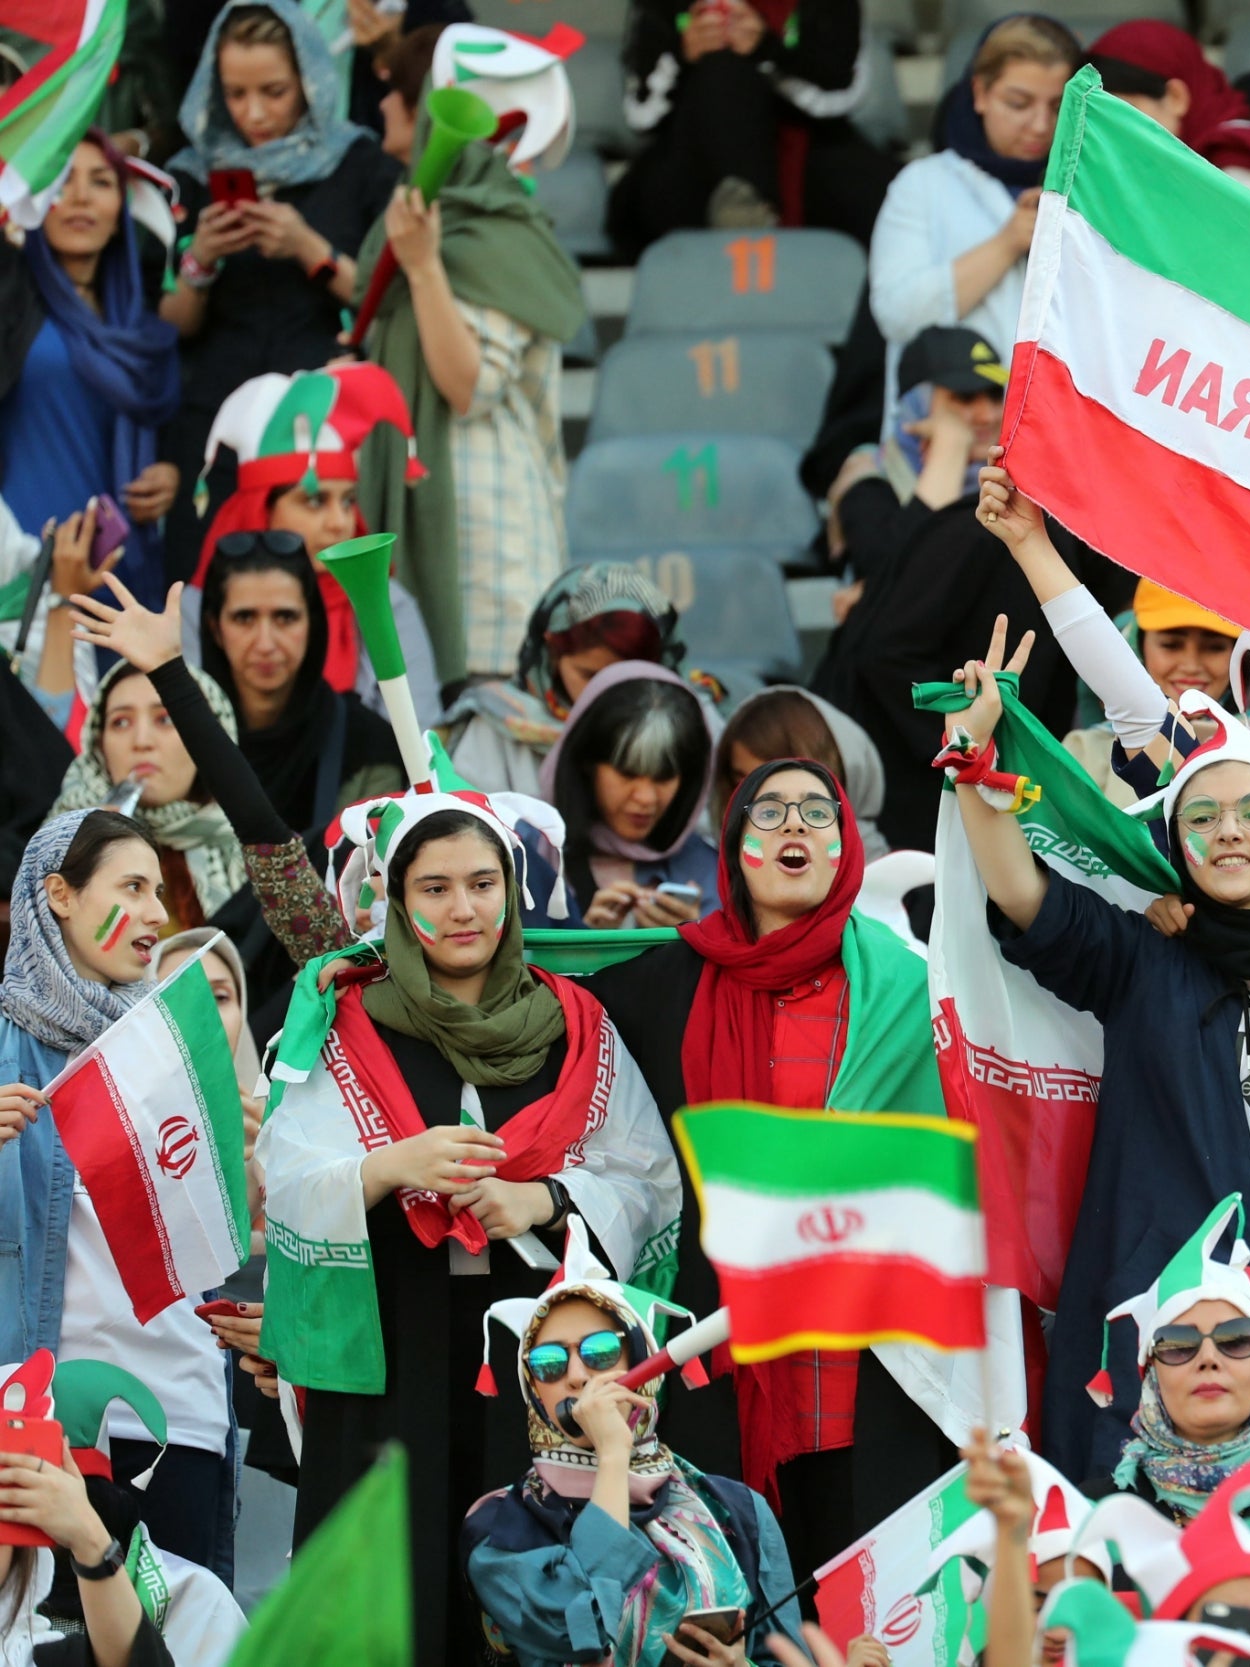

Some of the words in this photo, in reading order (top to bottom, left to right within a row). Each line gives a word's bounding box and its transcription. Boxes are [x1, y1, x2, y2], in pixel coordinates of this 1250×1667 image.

[725, 235, 776, 293] 11
[688, 336, 740, 395] 11
[662, 443, 719, 511] 11
